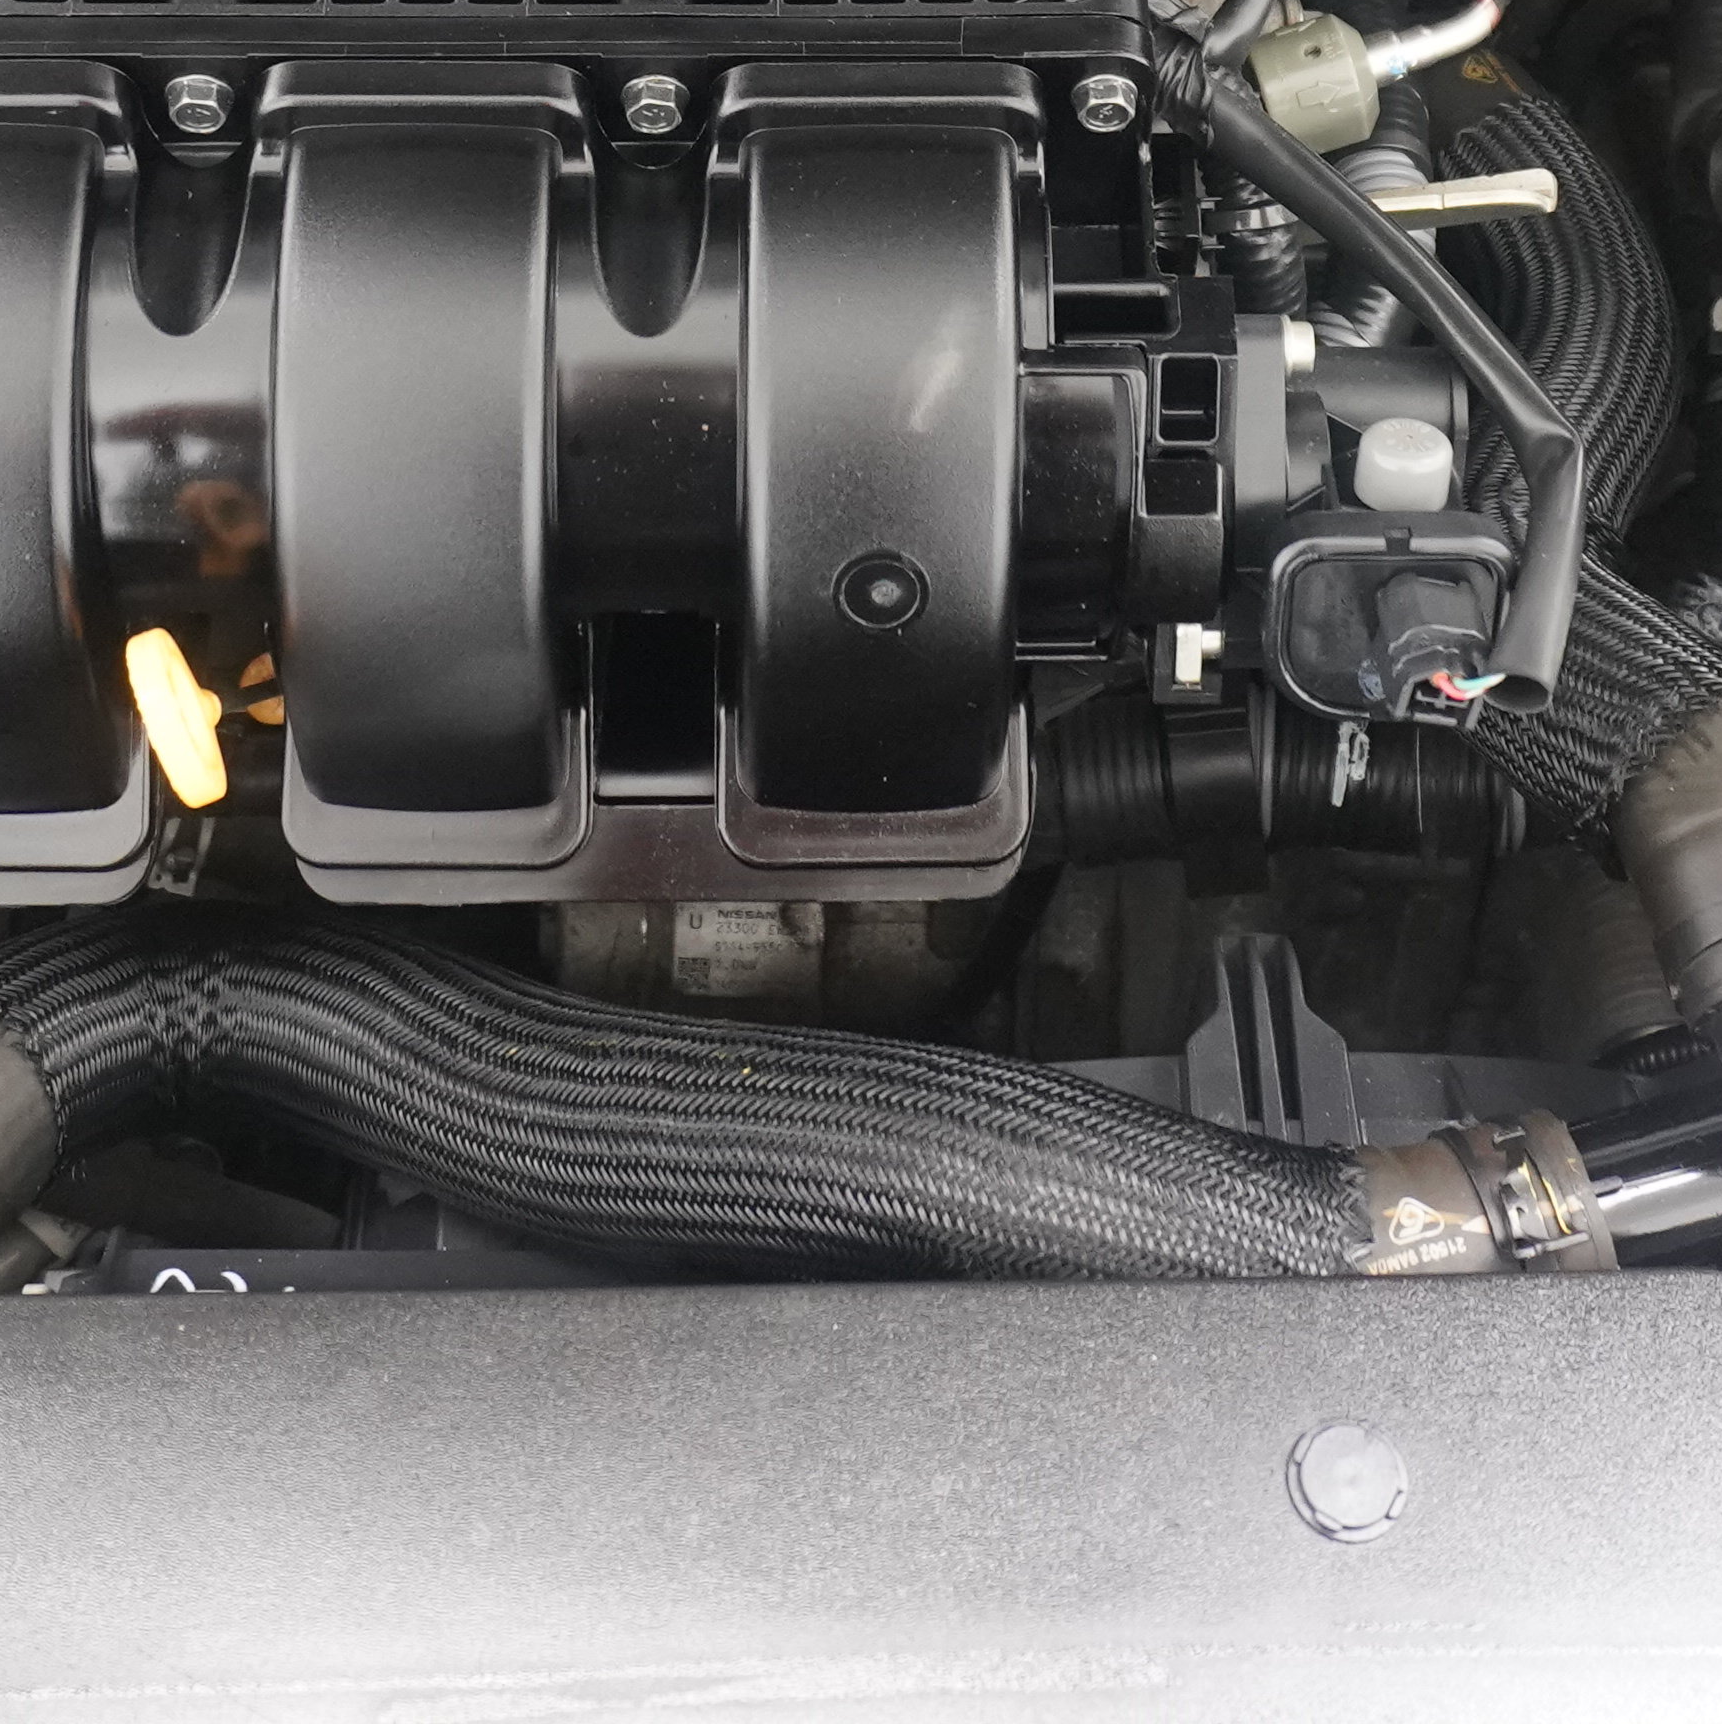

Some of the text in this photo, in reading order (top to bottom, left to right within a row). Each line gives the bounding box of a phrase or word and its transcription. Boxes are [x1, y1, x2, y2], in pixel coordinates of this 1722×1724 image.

[689, 909, 778, 930] U NISSAN
[716, 921, 759, 935] 23300
